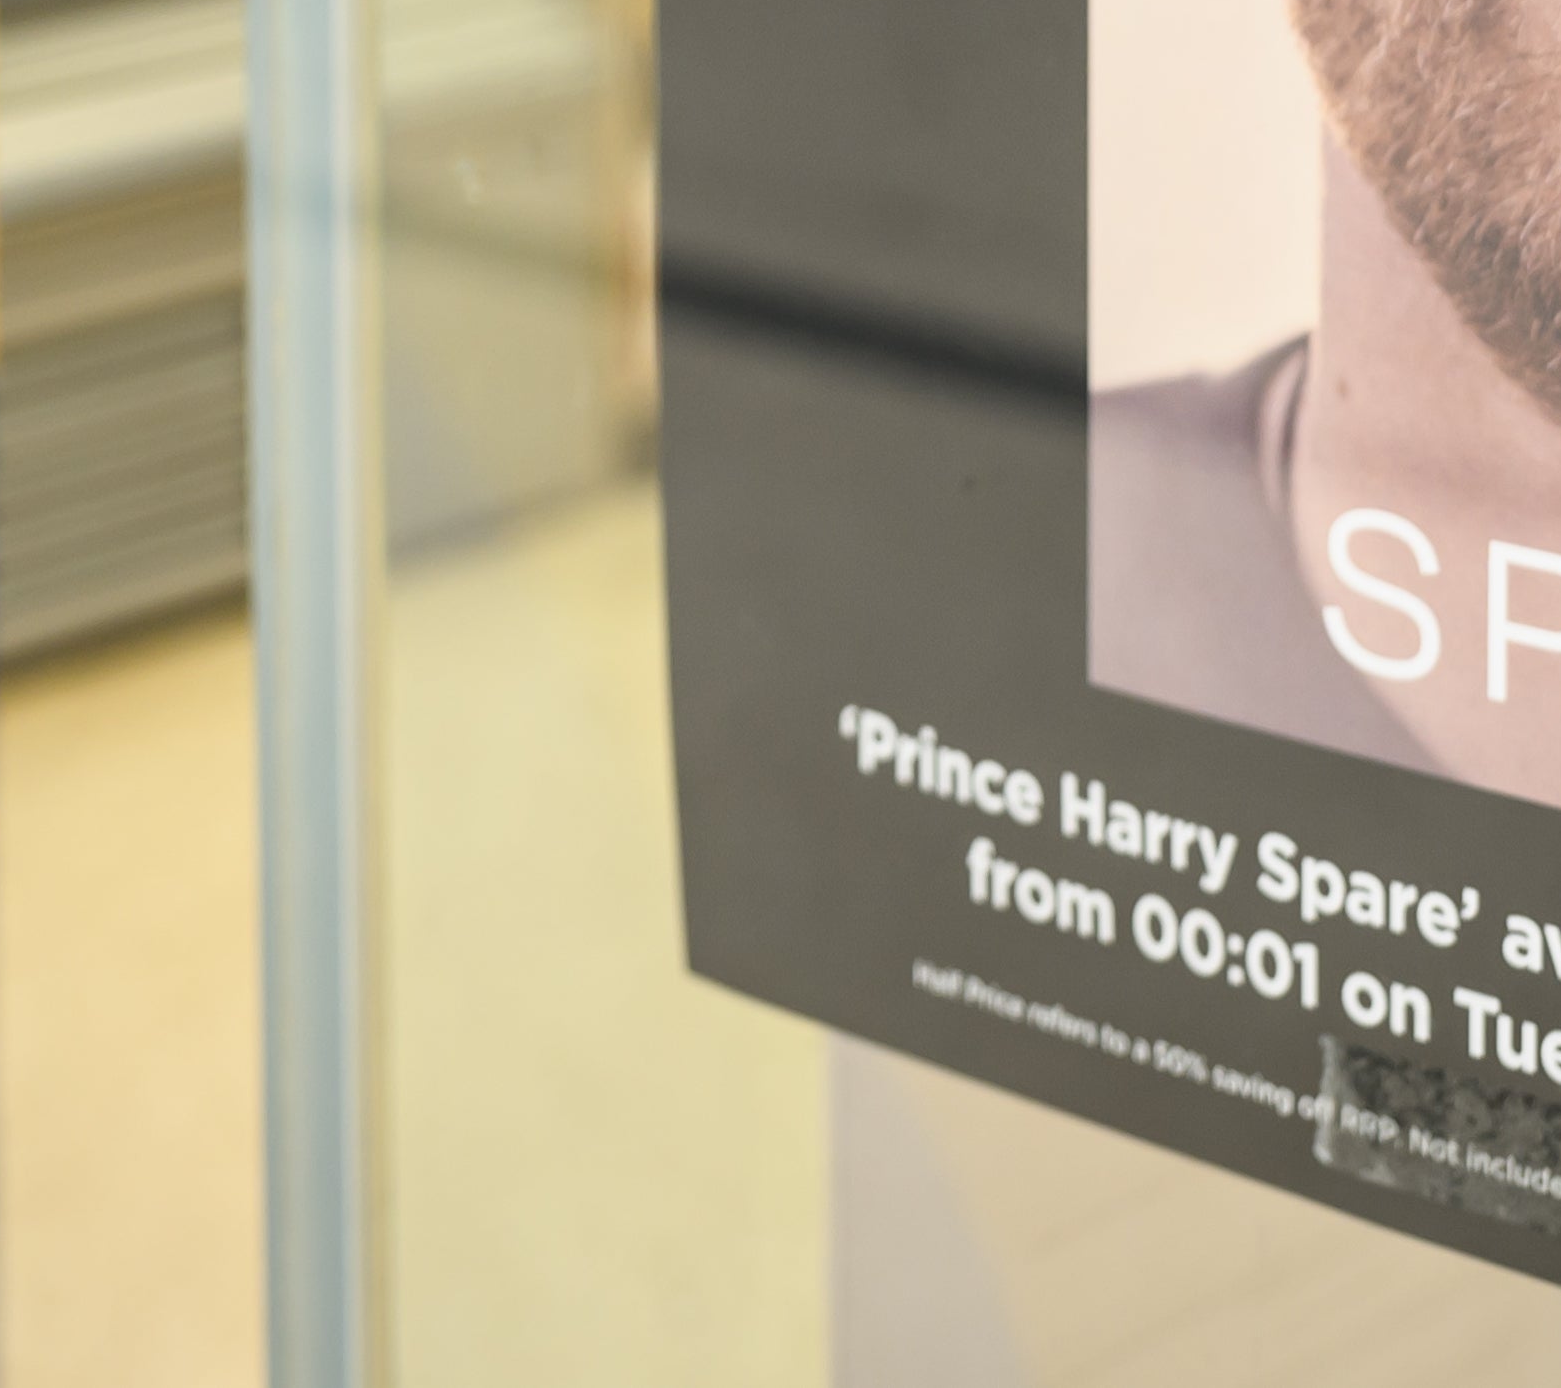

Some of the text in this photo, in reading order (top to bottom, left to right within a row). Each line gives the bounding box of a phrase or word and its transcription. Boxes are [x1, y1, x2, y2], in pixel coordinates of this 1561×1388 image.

[1060, 772, 1237, 892] Harry
[966, 837, 1116, 944] from
[1131, 894, 1320, 1009] 00:01
[1341, 971, 1432, 1042] on
[912, 957, 964, 999] Half
[963, 975, 1026, 1021] Price
[1027, 1002, 1099, 1047] refers
[1100, 1023, 1131, 1059] to
[1132, 1037, 1151, 1066] a
[1153, 1039, 1211, 1085] 50%
[1212, 1064, 1296, 1119] saving
[1409, 1127, 1460, 1166] Not
